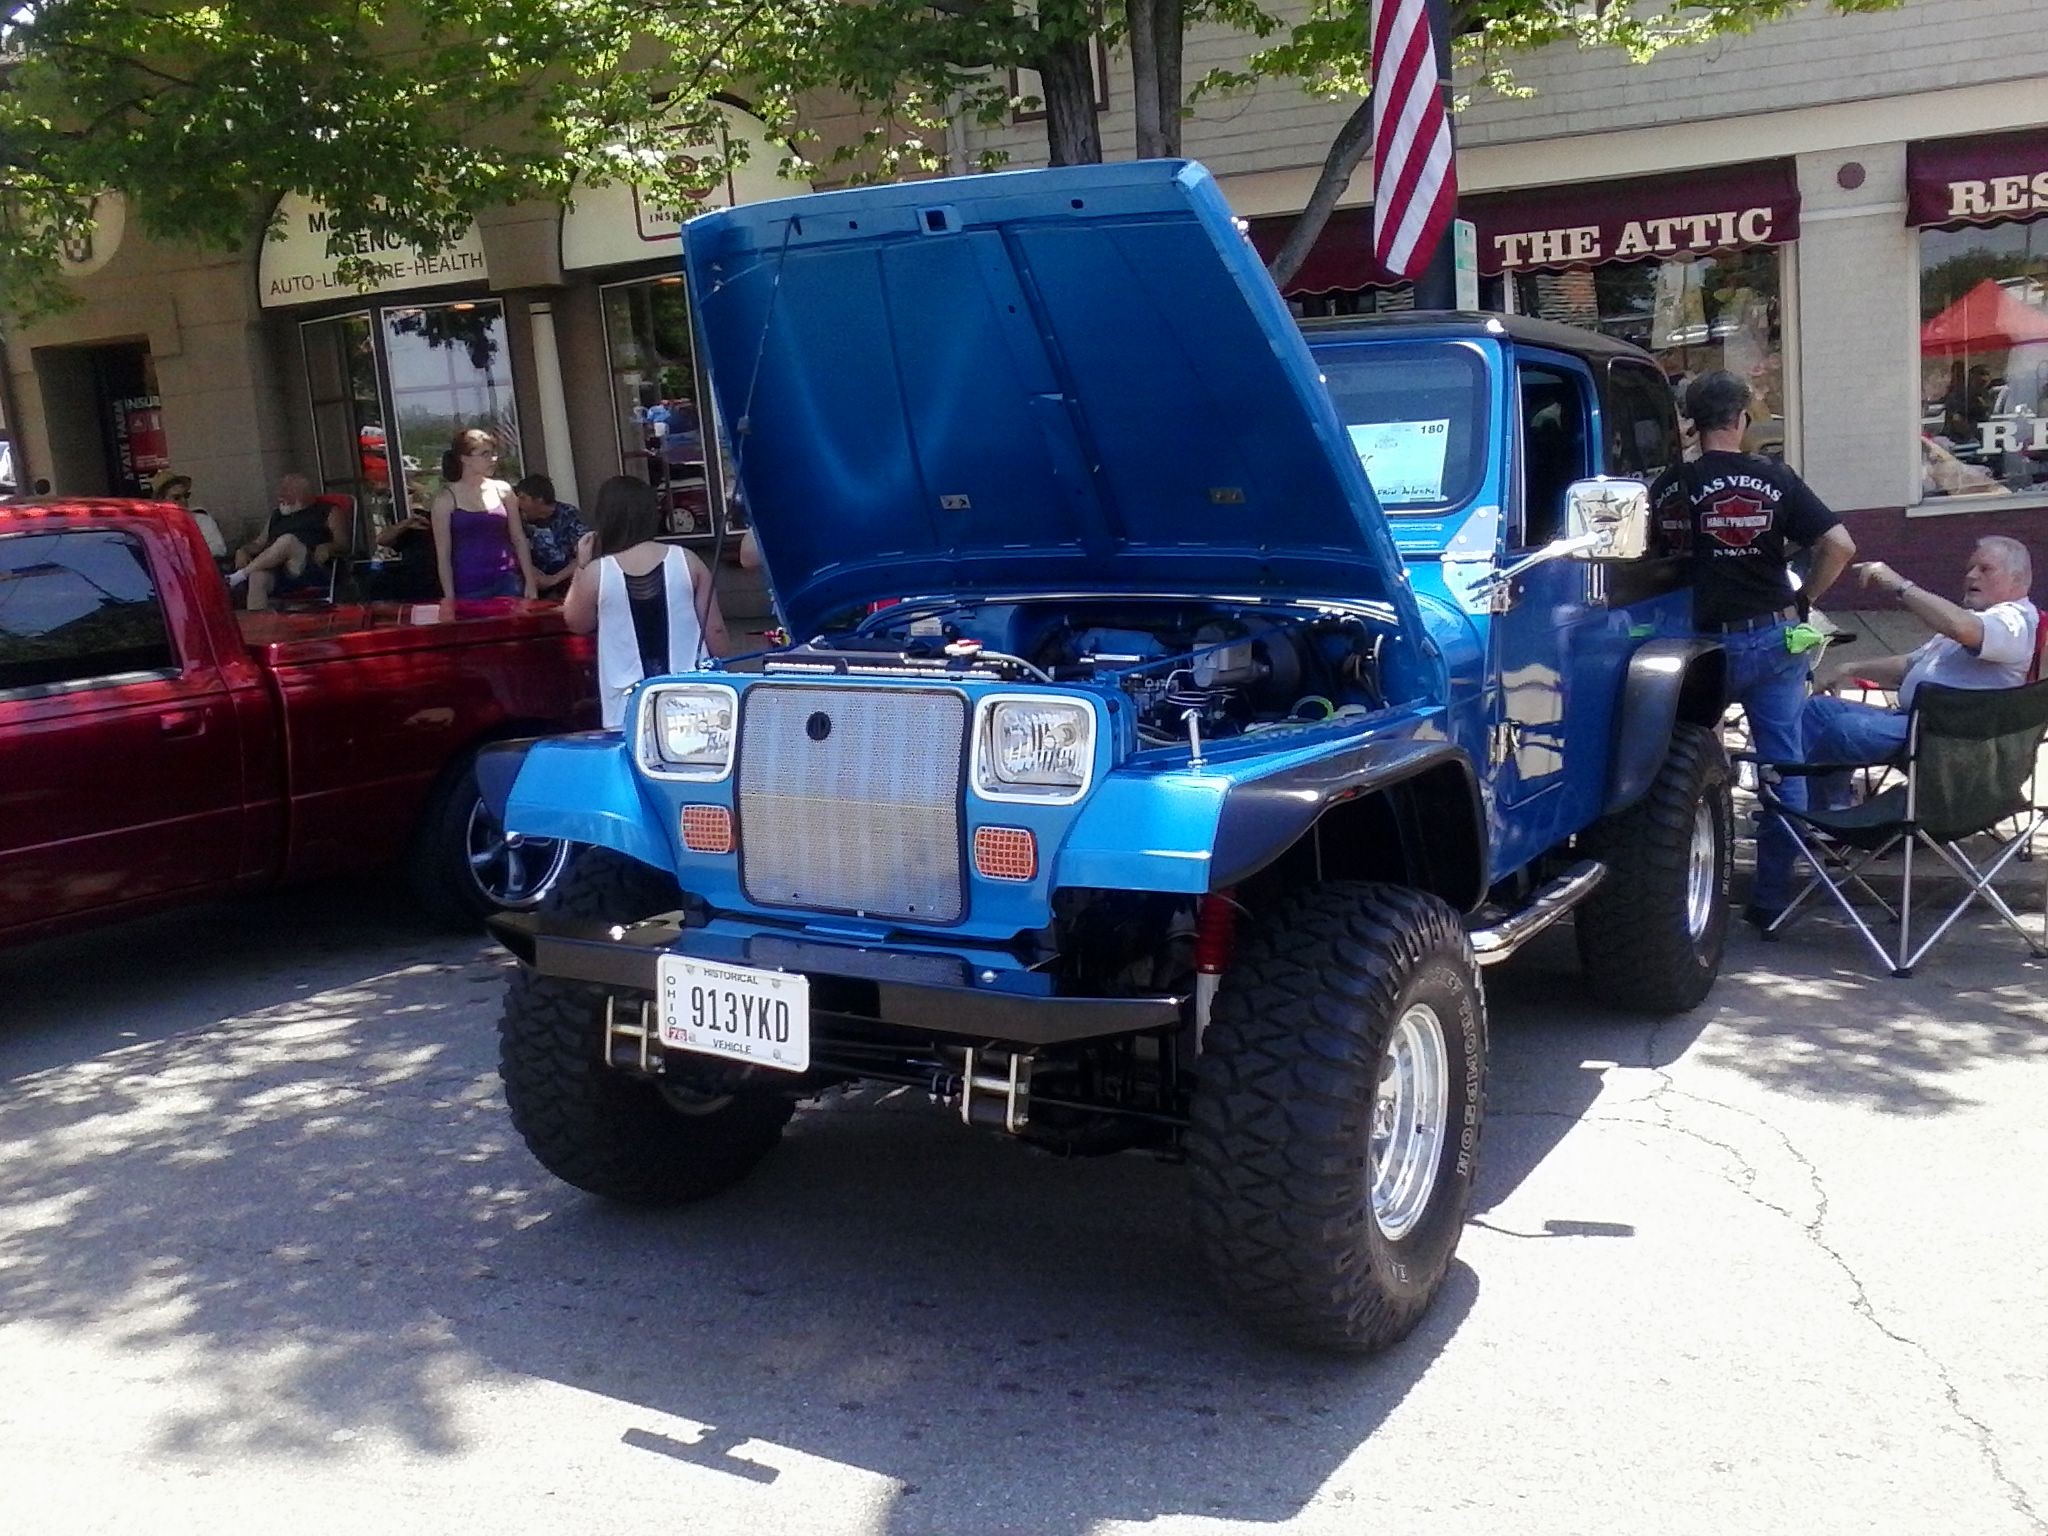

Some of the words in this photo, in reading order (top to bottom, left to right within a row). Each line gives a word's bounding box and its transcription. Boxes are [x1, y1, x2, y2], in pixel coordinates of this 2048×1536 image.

[1494, 226, 1600, 266] THE
[1615, 207, 1773, 255] ATTIC
[1420, 424, 1444, 434] 180
[1690, 478, 1725, 506] LAS
[1727, 475, 1783, 502] VEGAS
[703, 967, 759, 985] HISTORICAL
[666, 975, 677, 1026] OHIO
[691, 986, 790, 1044] 913YKD
[712, 1038, 752, 1055] VEHICLE
[1456, 993, 1478, 1177] THOMPSON
